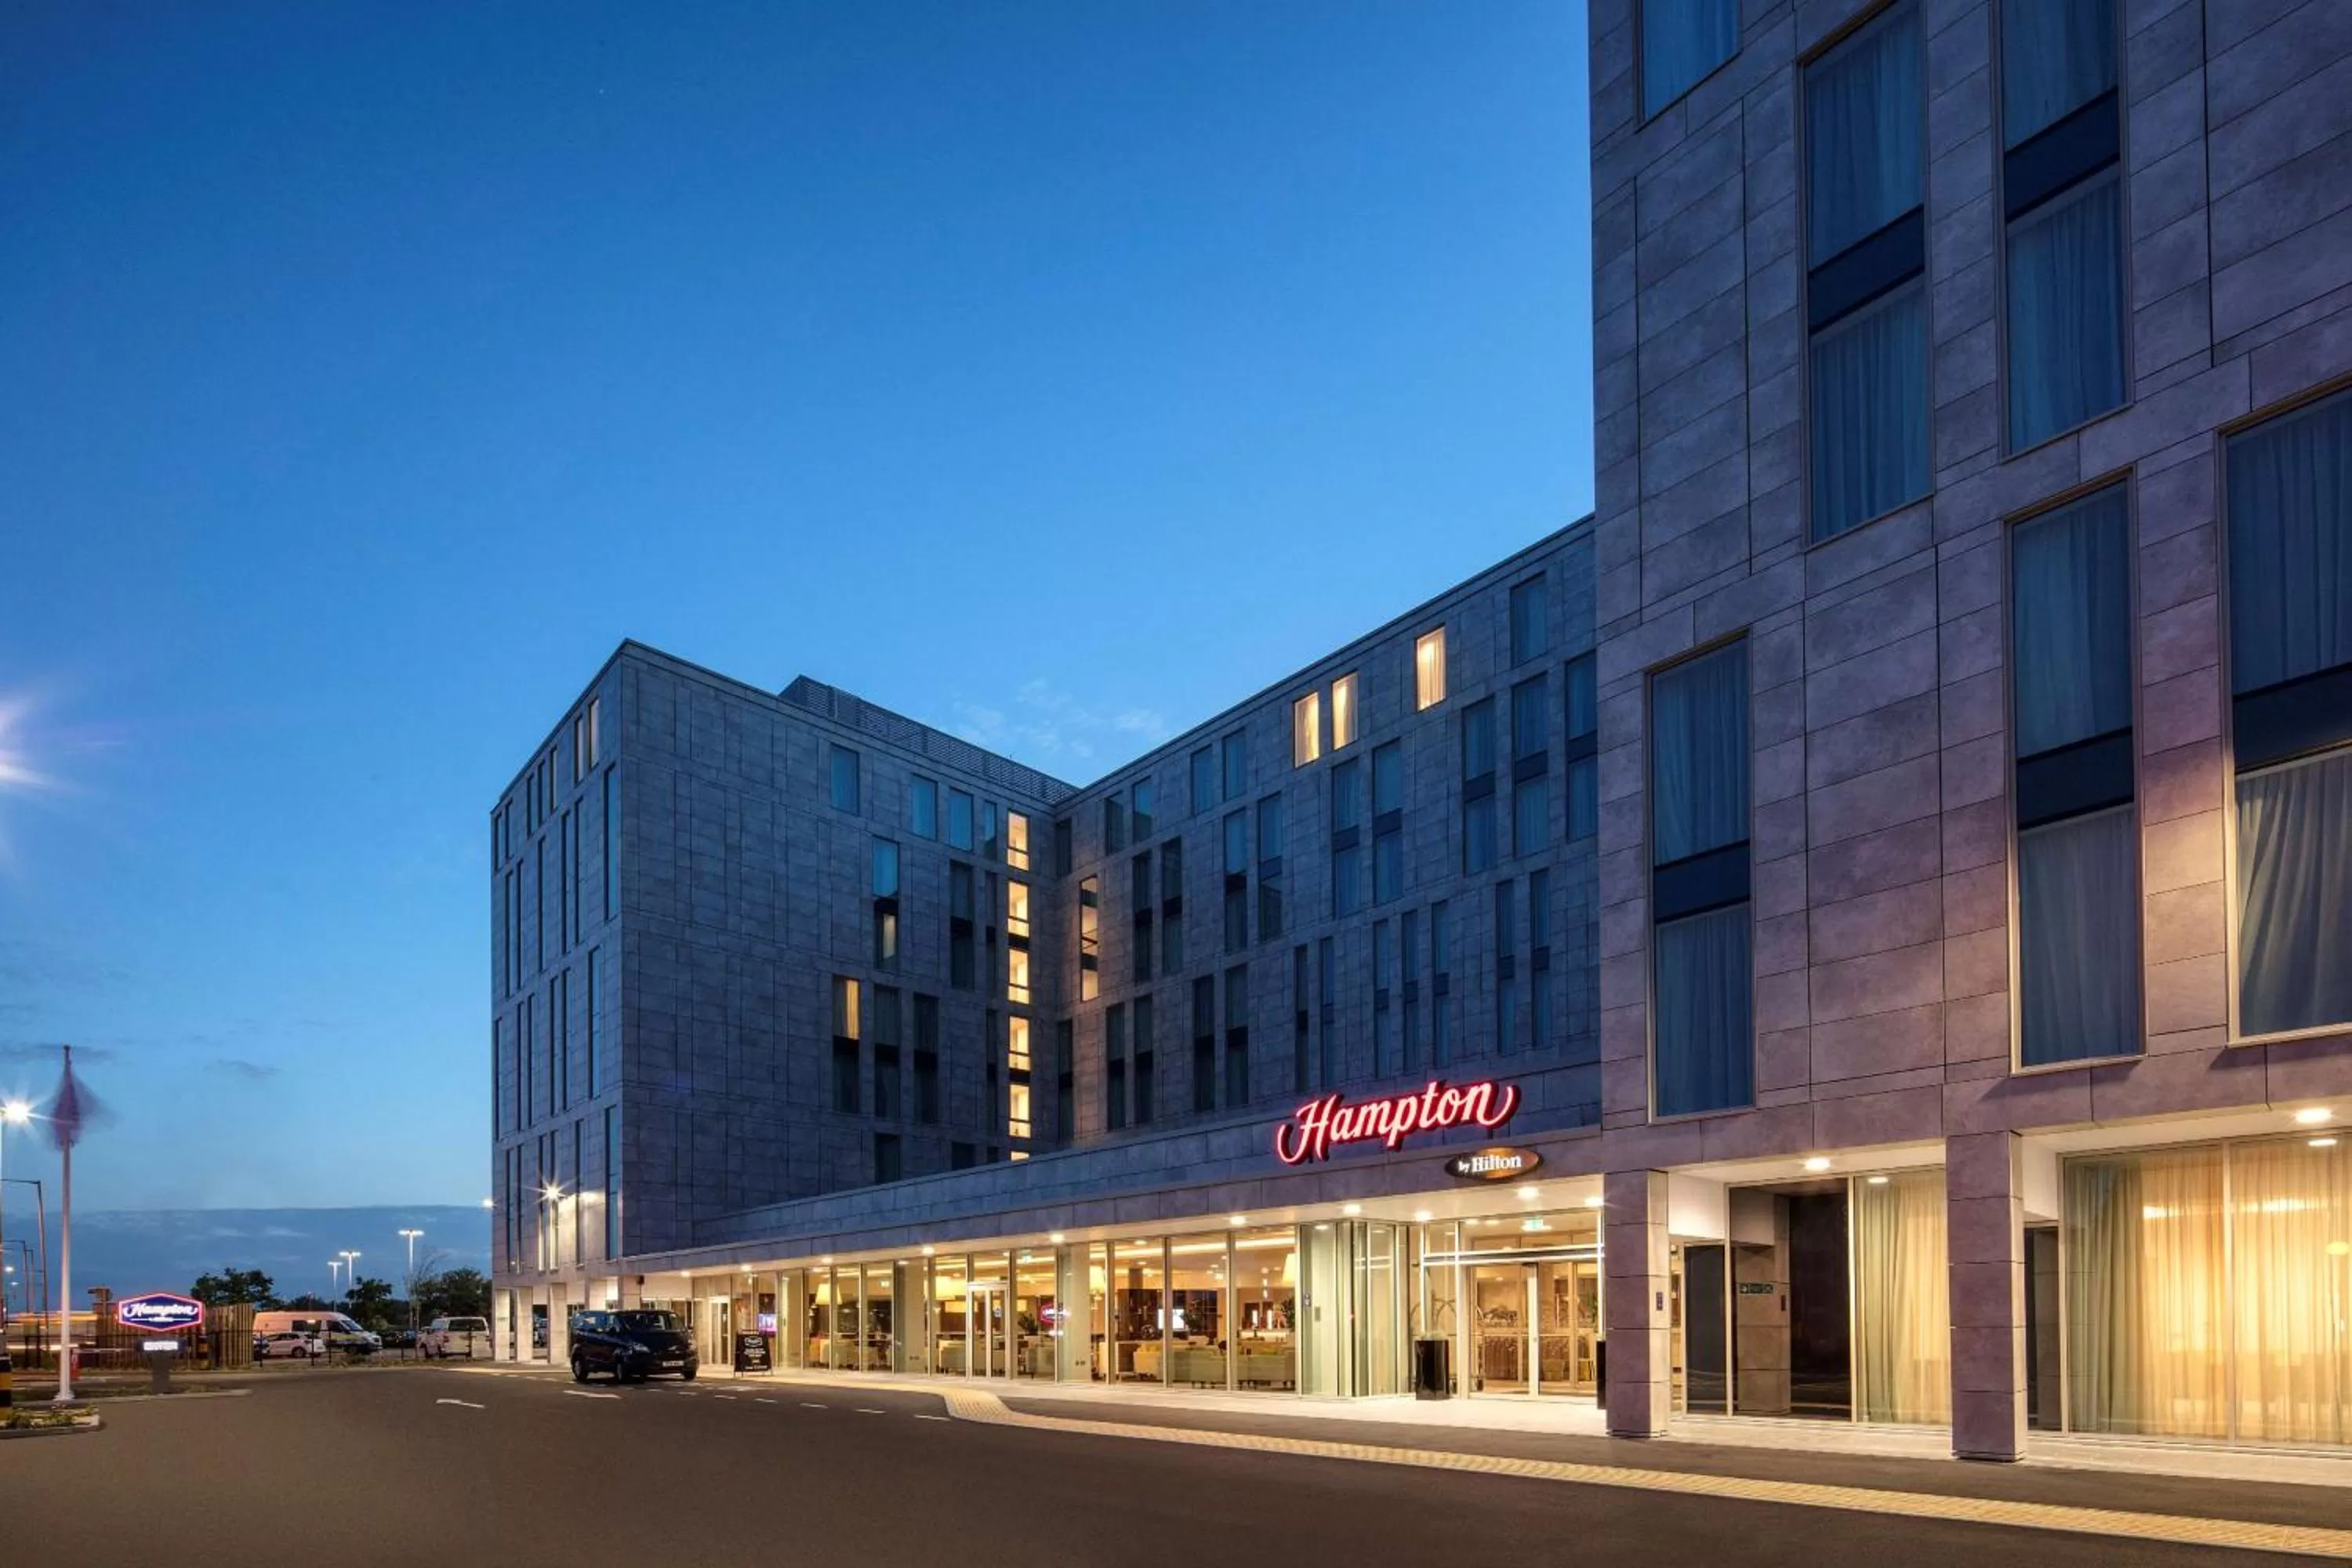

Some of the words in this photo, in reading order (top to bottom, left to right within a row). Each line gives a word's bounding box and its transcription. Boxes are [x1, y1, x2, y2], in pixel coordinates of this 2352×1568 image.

[1276, 1080, 1519, 1164] Hampton
[1458, 1160, 1471, 1173] by
[1472, 1154, 1522, 1173] Hilton
